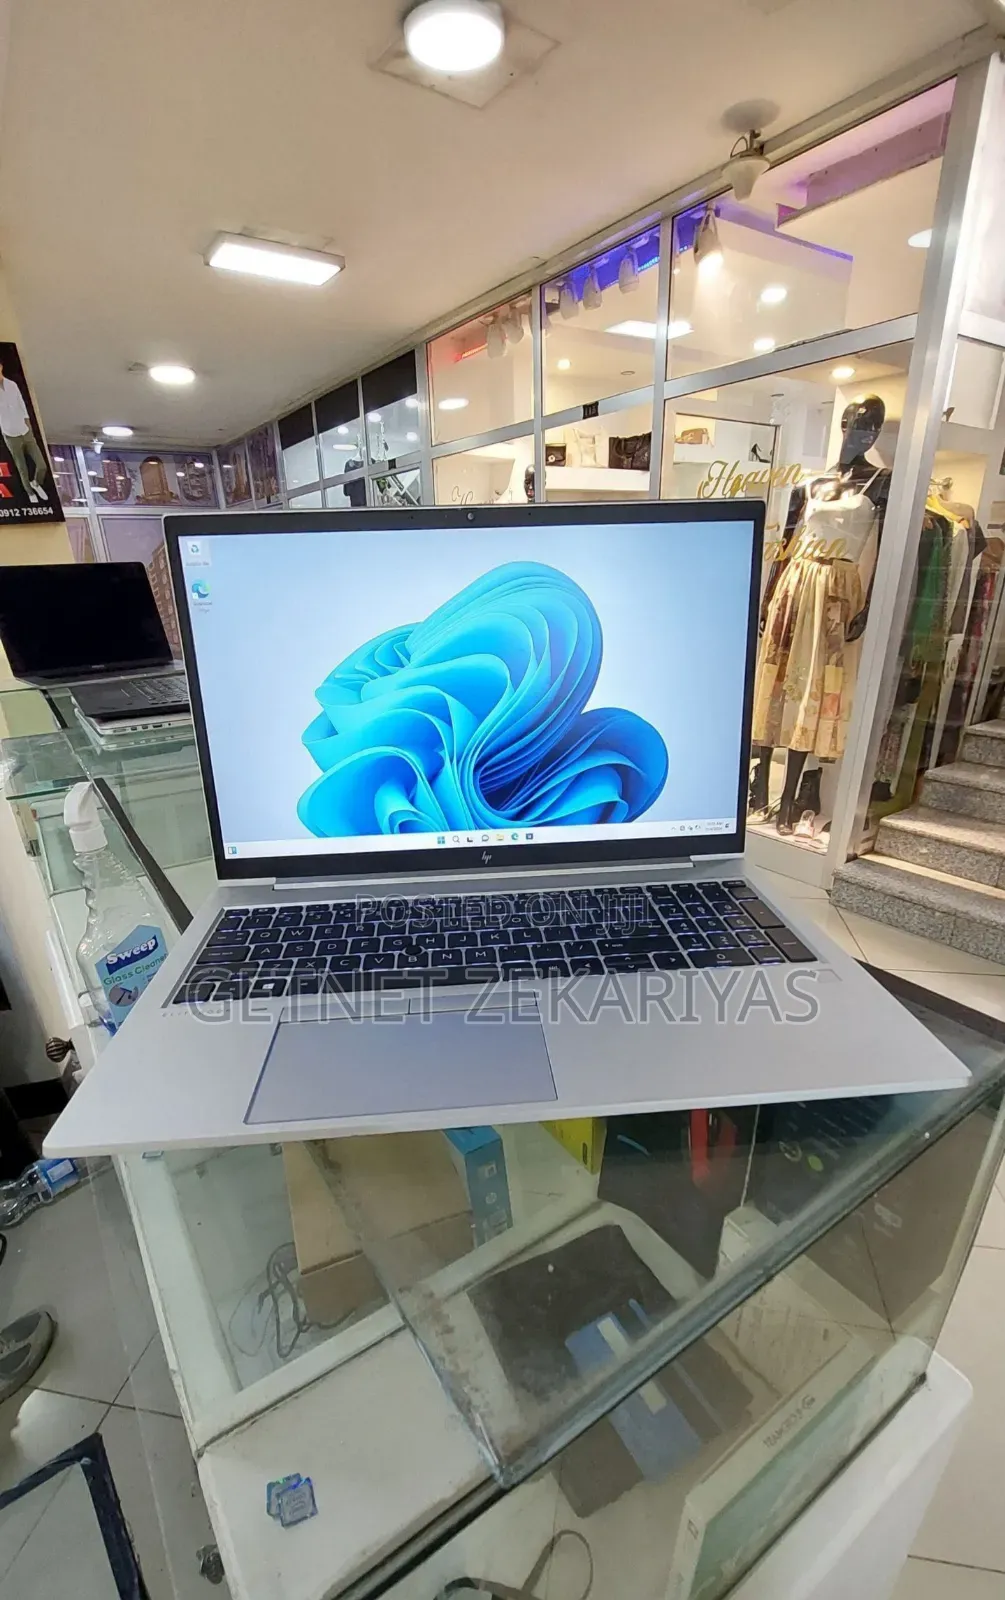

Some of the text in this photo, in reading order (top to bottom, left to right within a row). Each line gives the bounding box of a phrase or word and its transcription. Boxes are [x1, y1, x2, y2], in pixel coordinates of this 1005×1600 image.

[764, 522, 848, 562] ashion
[106, 938, 156, 964] Sweep
[103, 971, 134, 986] Glass
